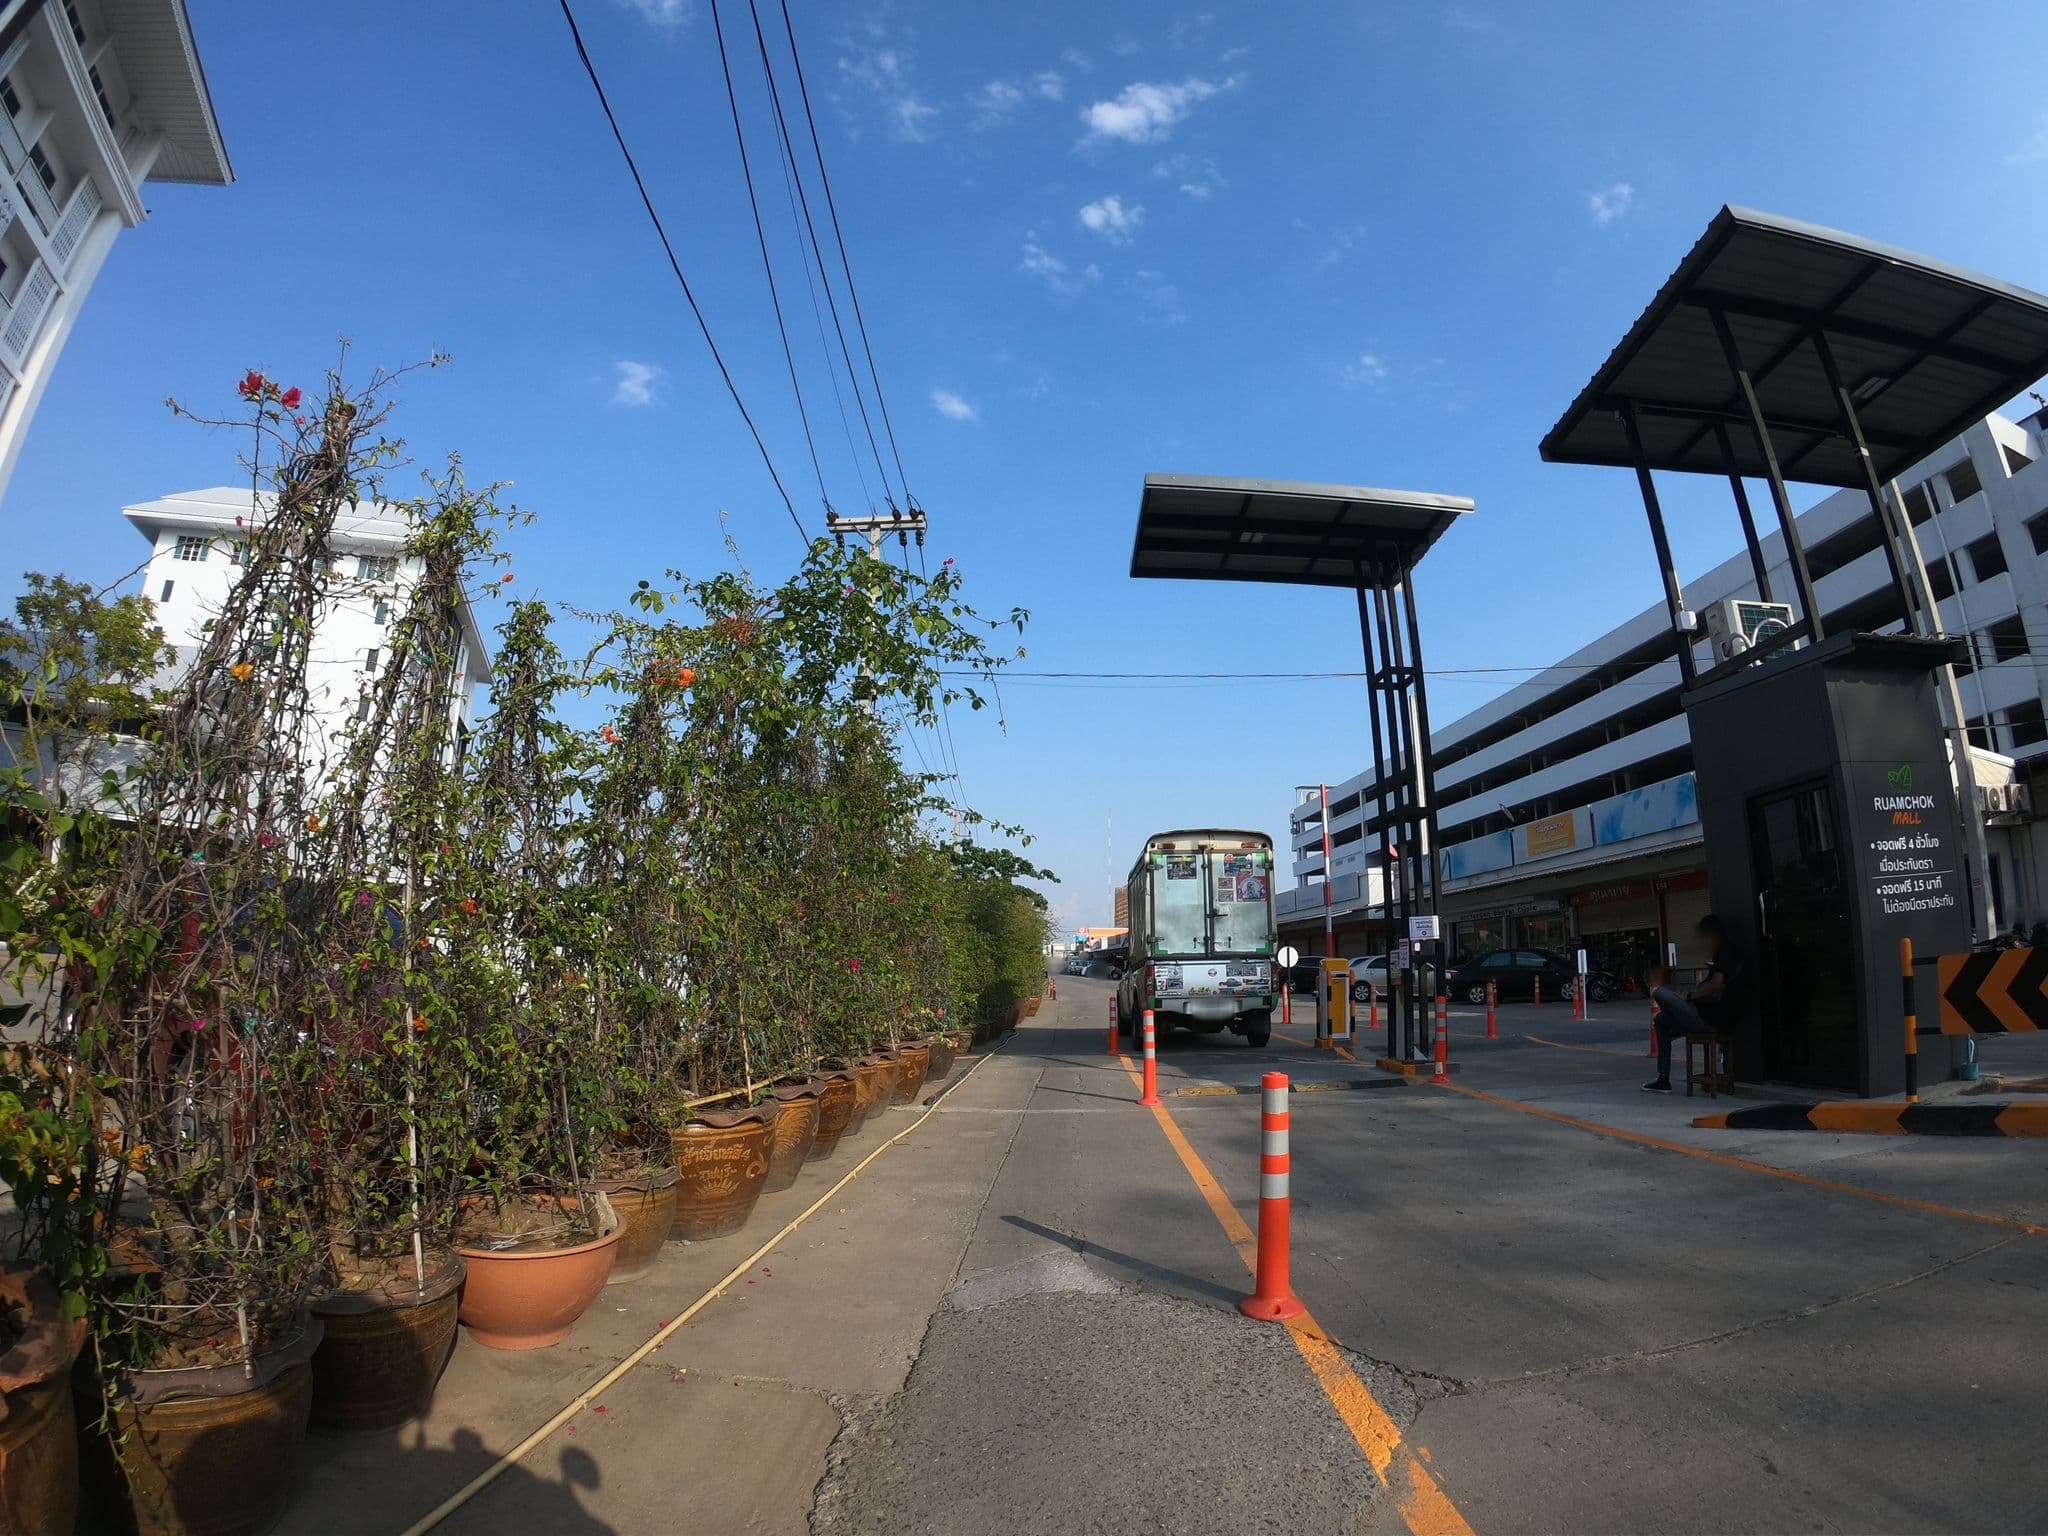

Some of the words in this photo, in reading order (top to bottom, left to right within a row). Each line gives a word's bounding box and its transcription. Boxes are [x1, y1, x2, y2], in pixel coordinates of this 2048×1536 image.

[1874, 795, 1935, 811] RUAMCHOK
[1892, 811, 1922, 825] MALL
[1877, 836, 1907, 851] จอดฟรี
[1908, 839, 1914, 849] 4
[1916, 832, 1940, 849] ชั่วโมง
[1882, 878, 1912, 894] จอดฟรี
[1914, 879, 1925, 892] 15
[1926, 875, 1943, 890] นาที
